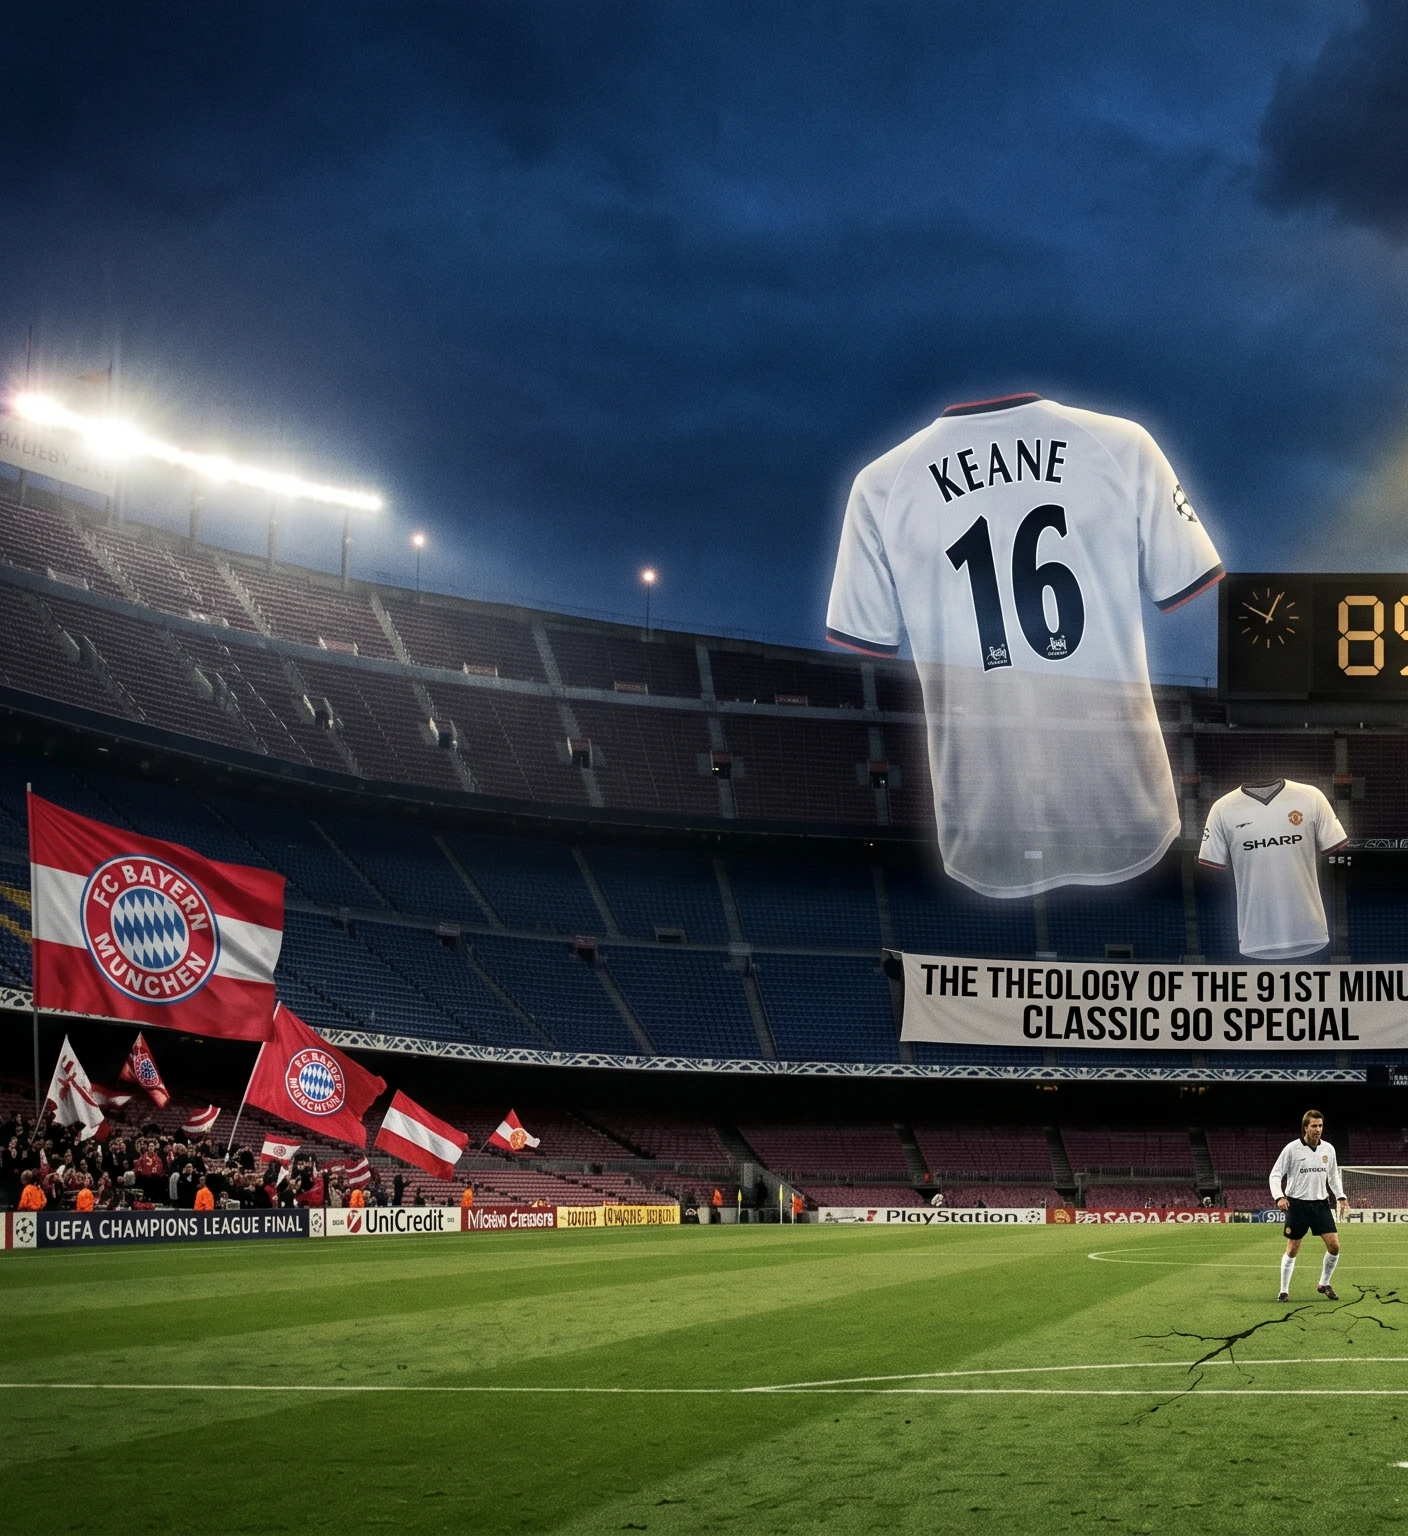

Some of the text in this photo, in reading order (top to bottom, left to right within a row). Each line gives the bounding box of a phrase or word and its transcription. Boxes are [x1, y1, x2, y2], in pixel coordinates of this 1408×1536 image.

[928, 438, 1068, 503] KEANE
[945, 503, 1086, 672] 16
[1243, 834, 1303, 851] SHARP
[92, 865, 208, 932] FC BAYERN
[921, 964, 978, 997] THE
[987, 966, 1139, 1001] THEOLOGY
[1148, 971, 1184, 1002] OF
[1192, 971, 1248, 1002] THE
[1257, 971, 1331, 1002] 91ST
[1023, 1004, 1360, 1042] CLASSIC 90 SPECIAL
[45, 1215, 303, 1241] UEFA CHAMPIONS LEAGUE FINAL
[365, 1209, 444, 1233] UniCredit
[886, 1210, 1018, 1225] PlayStation
